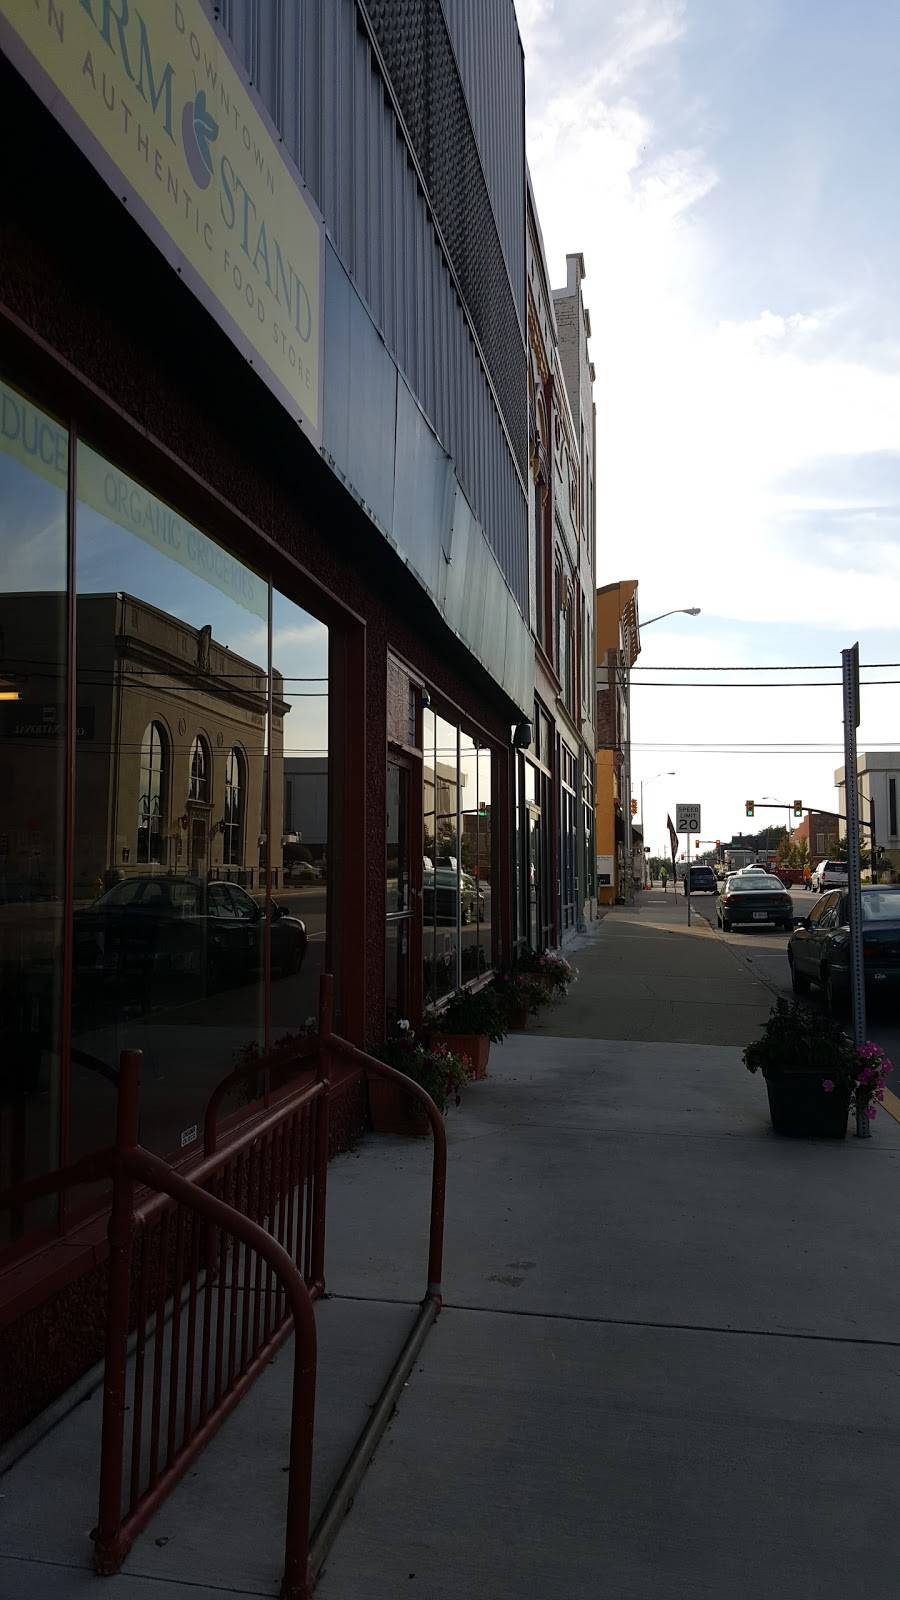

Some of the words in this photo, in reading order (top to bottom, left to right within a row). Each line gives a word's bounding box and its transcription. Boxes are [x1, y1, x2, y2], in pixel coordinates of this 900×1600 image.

[80, 0, 176, 146] RM
[219, 155, 311, 343] STAND
[175, 2, 274, 195] DOWNTOWN
[82, 50, 212, 251] AUTHENTIC
[223, 249, 264, 322] FOOD
[272, 322, 310, 390] STORE
[104, 471, 181, 550] ORGANIC
[678, 819, 698, 830] 20
